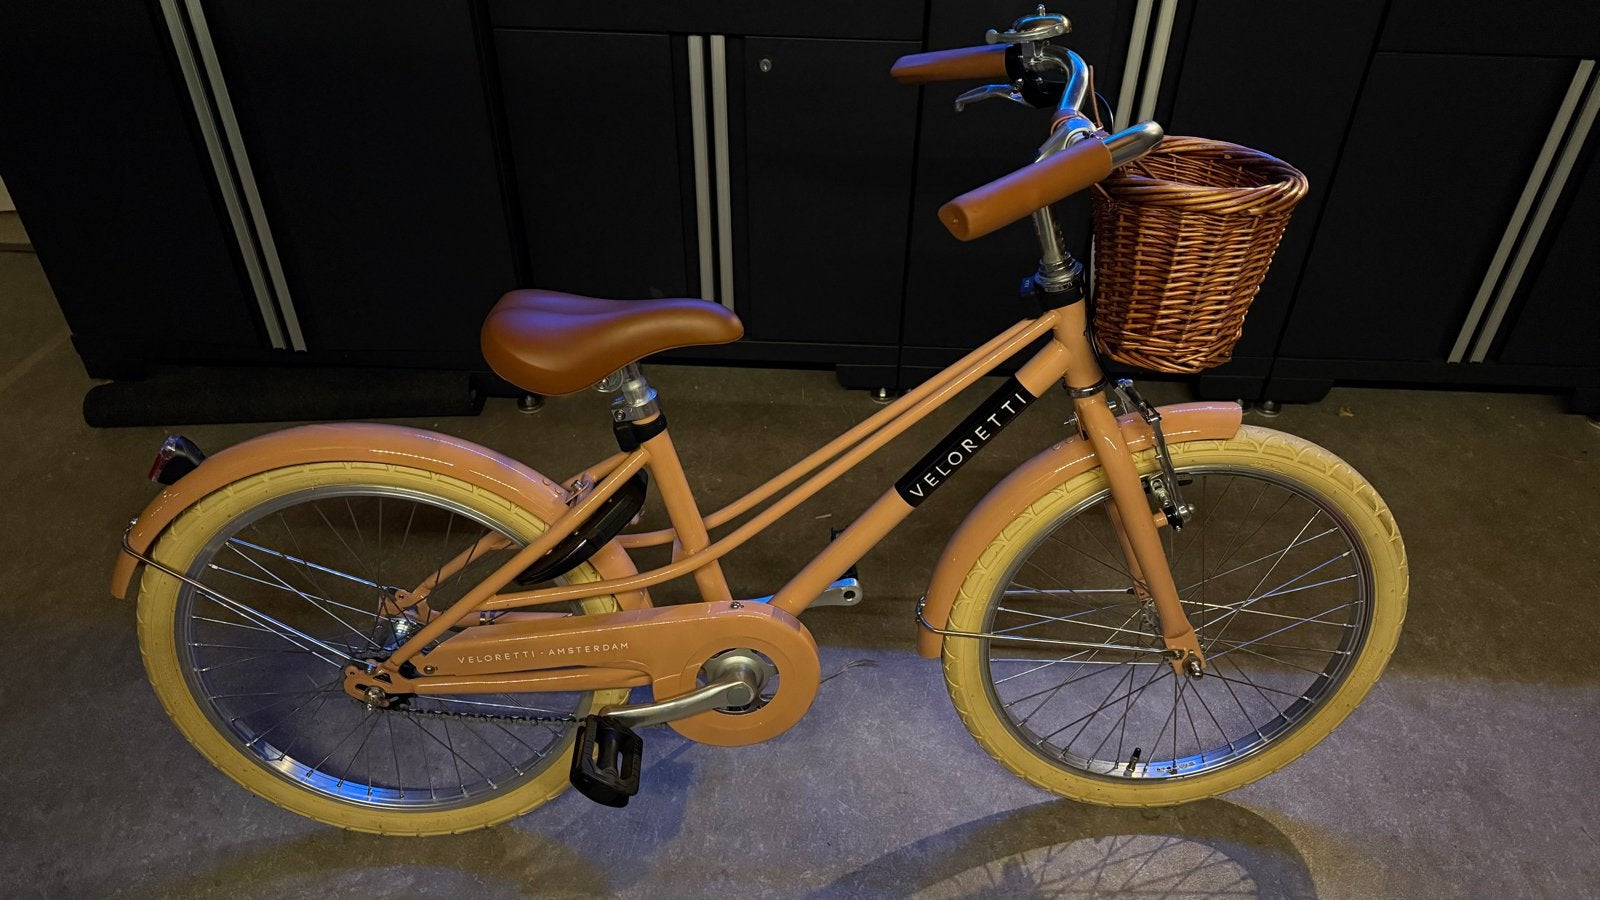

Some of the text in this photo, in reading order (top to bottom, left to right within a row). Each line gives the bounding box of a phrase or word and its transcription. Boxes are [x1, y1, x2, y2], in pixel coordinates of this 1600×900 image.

[909, 392, 1027, 497] VELORETTI
[457, 642, 630, 665] VELORETTI AMSTERDAM
